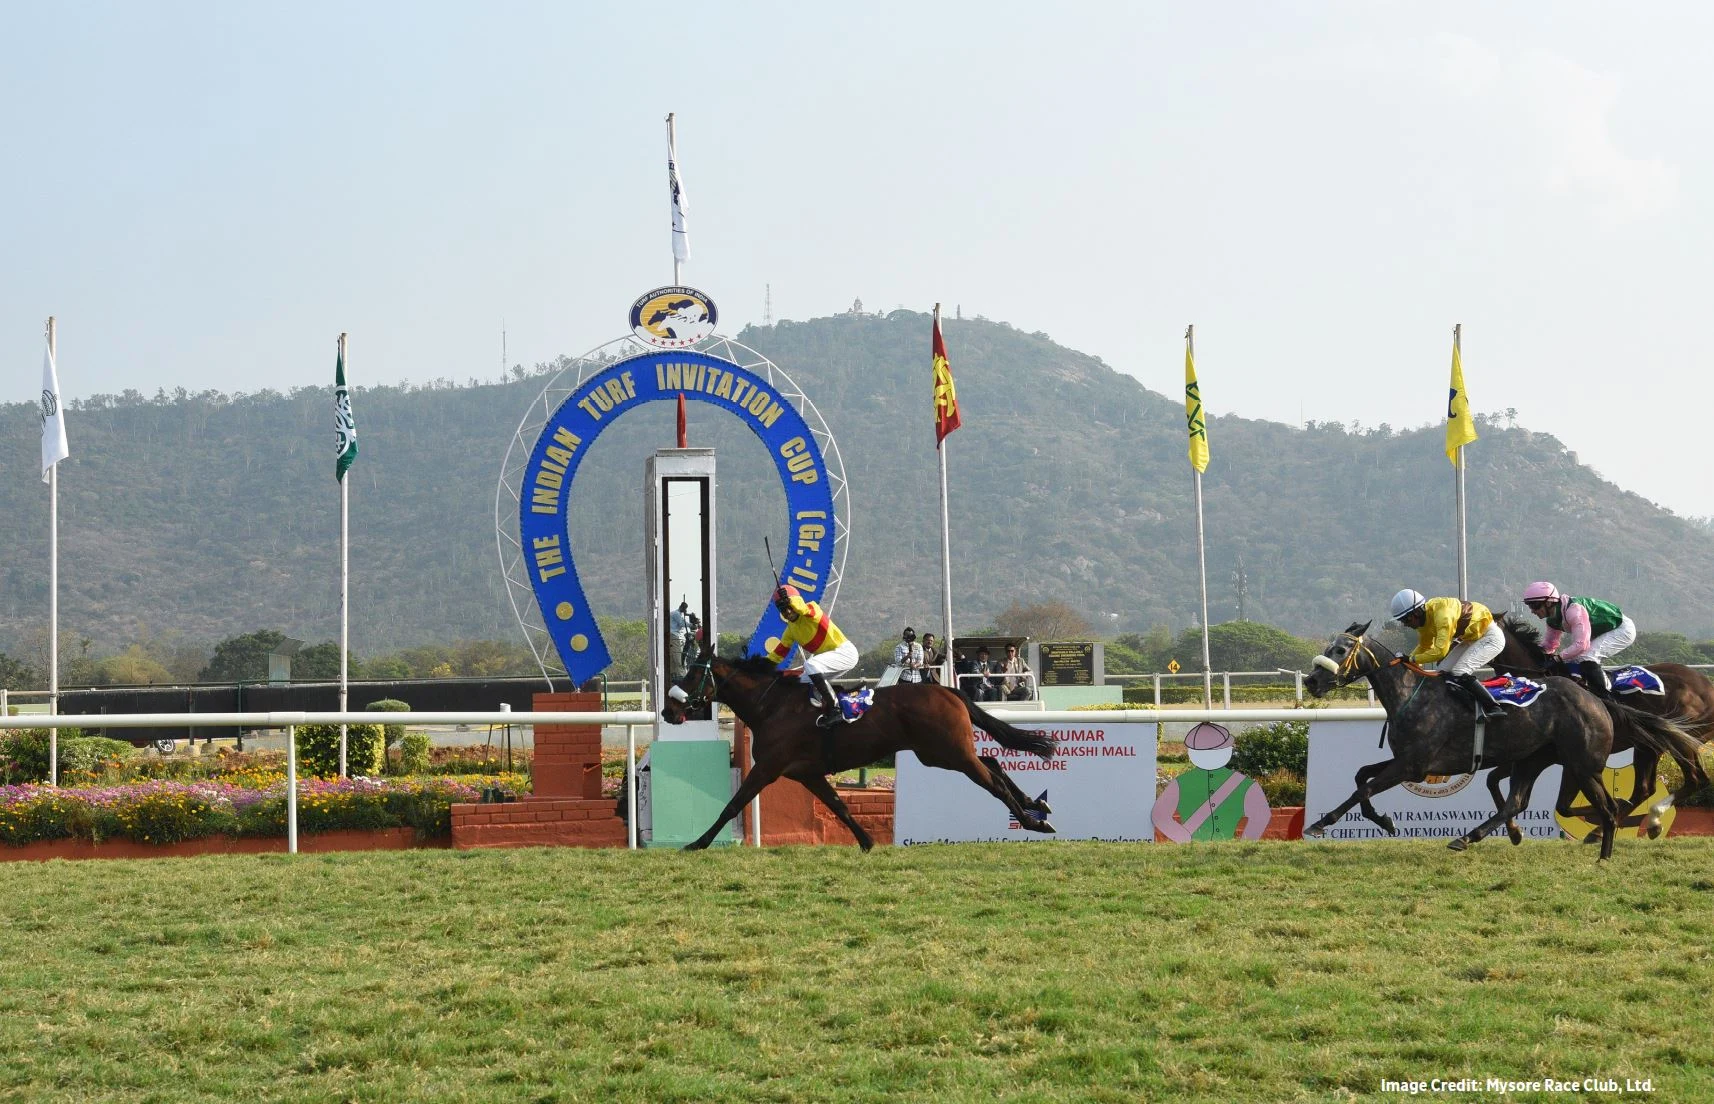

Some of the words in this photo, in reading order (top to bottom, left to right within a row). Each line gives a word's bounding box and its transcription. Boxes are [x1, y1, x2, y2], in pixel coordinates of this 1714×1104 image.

[636, 296, 649, 308] TURF
[649, 288, 685, 300] AUTHORITIES
[694, 292, 708, 304] INDIA
[577, 371, 637, 421] TURF
[655, 363, 785, 428] INVITATION
[532, 426, 582, 514] INDIAN
[780, 436, 819, 486] CUP
[533, 534, 566, 583] THE
[1051, 730, 1105, 742] KUMAR
[981, 747, 1021, 757] ROYAL
[1102, 746, 1136, 757] MALL
[1001, 760, 1067, 771] ANGALORE
[1345, 812, 1364, 822] DR.
[1406, 810, 1484, 821] RAMASWAMY
[1530, 826, 1554, 836] CUP
